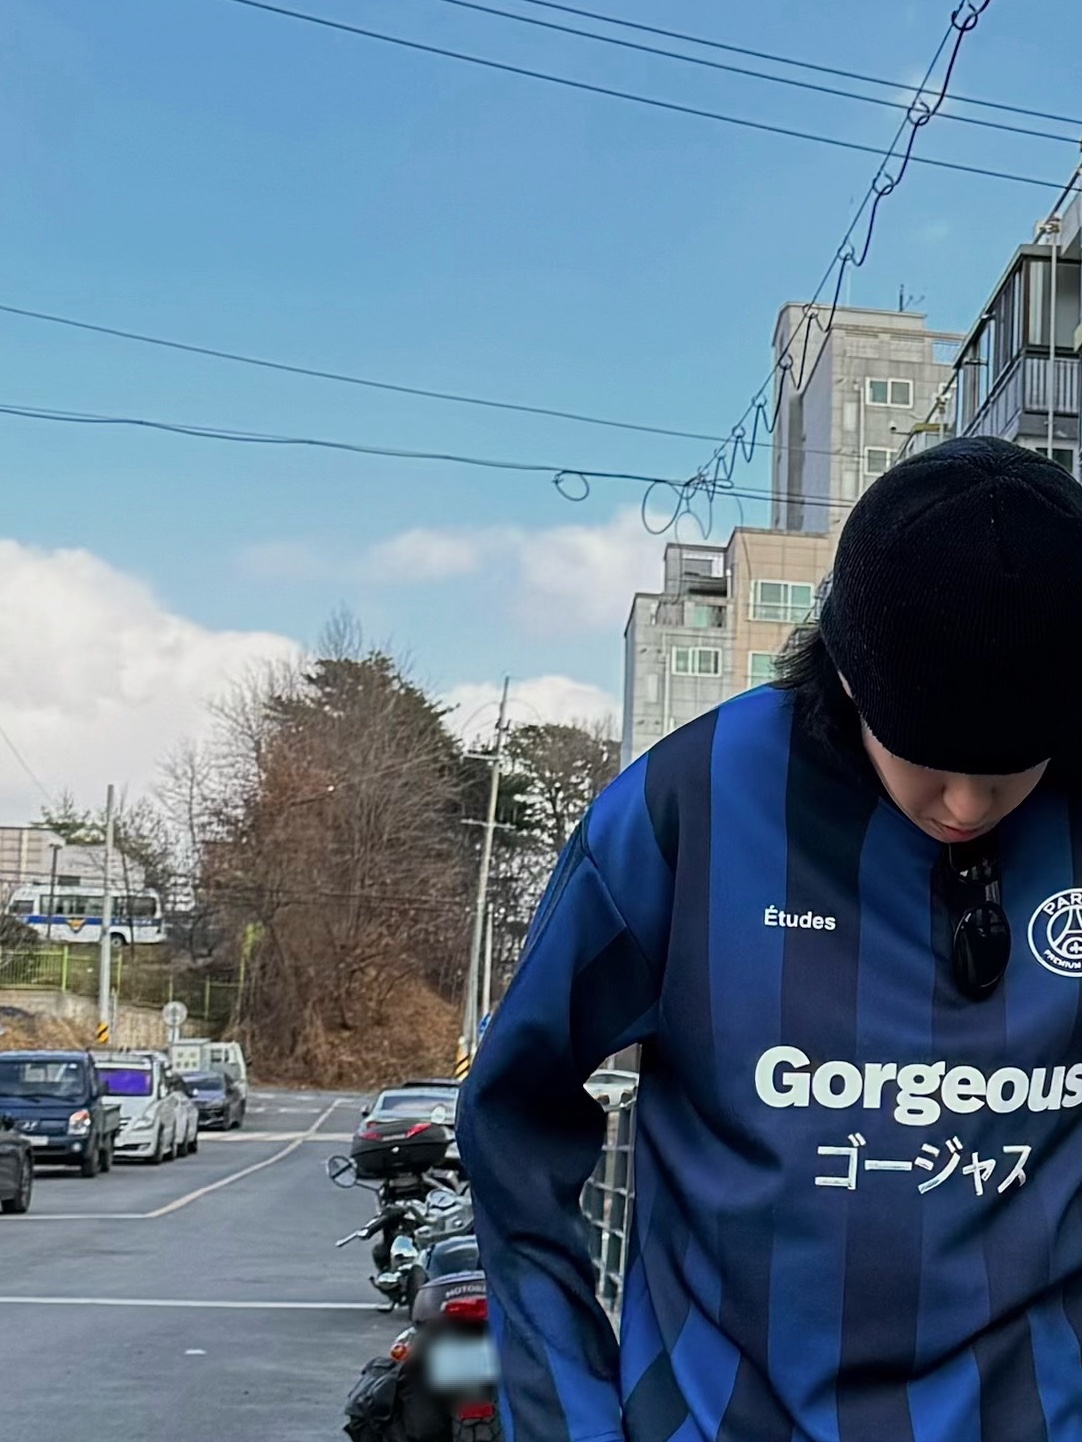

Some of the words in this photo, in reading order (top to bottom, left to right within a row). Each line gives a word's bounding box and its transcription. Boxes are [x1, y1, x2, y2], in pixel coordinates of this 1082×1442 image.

[763, 904, 837, 931] Études
[1043, 949, 1082, 969] PREMIUM
[814, 1132, 1033, 1197] ゴージャス
